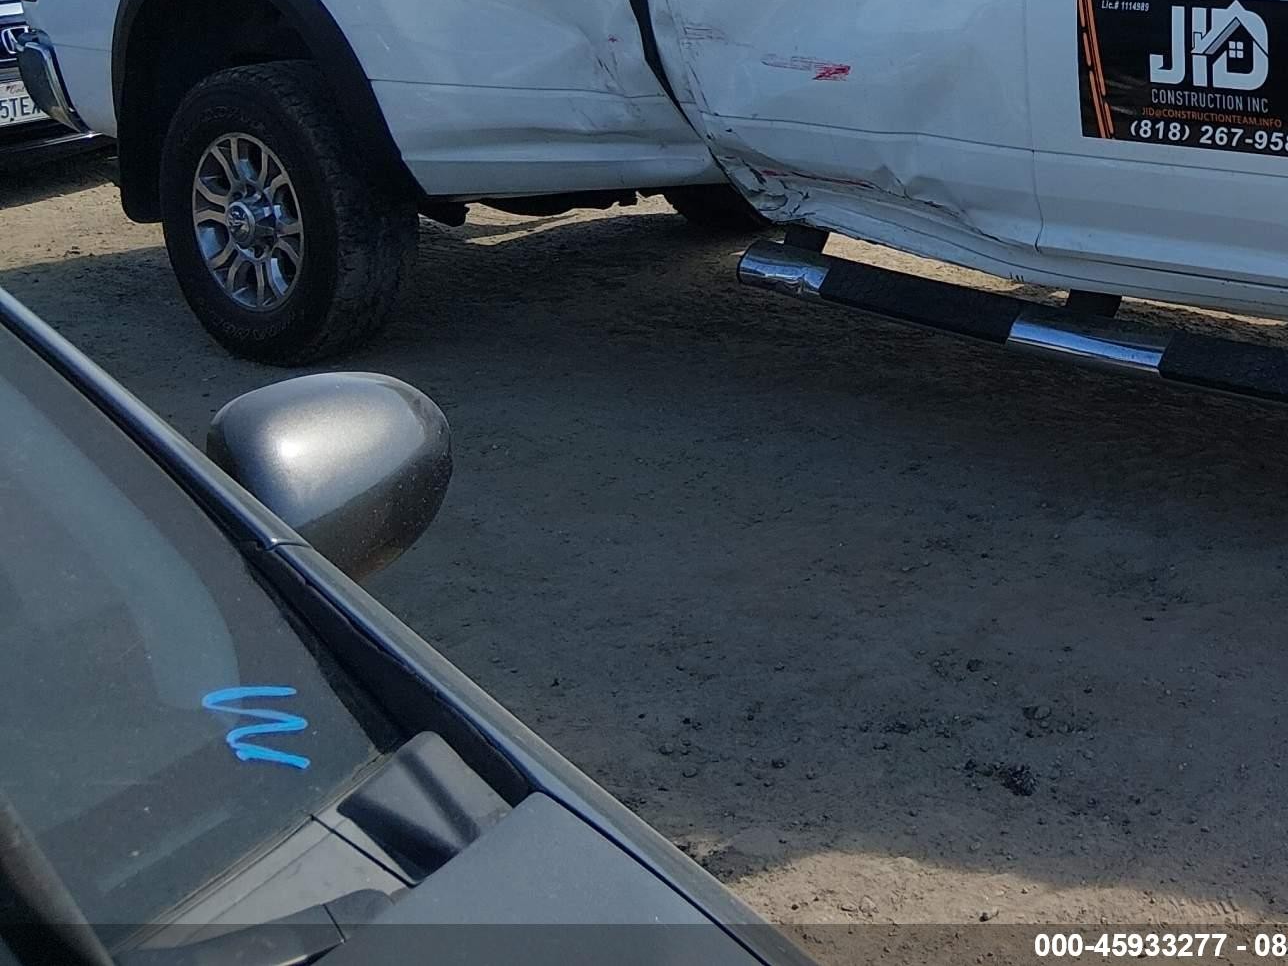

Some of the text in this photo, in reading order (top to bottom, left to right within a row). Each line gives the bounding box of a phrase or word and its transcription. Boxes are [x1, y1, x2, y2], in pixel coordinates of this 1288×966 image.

[1151, 89, 1269, 113] CONSTRUCTION INC
[1130, 119, 1190, 141] (818)
